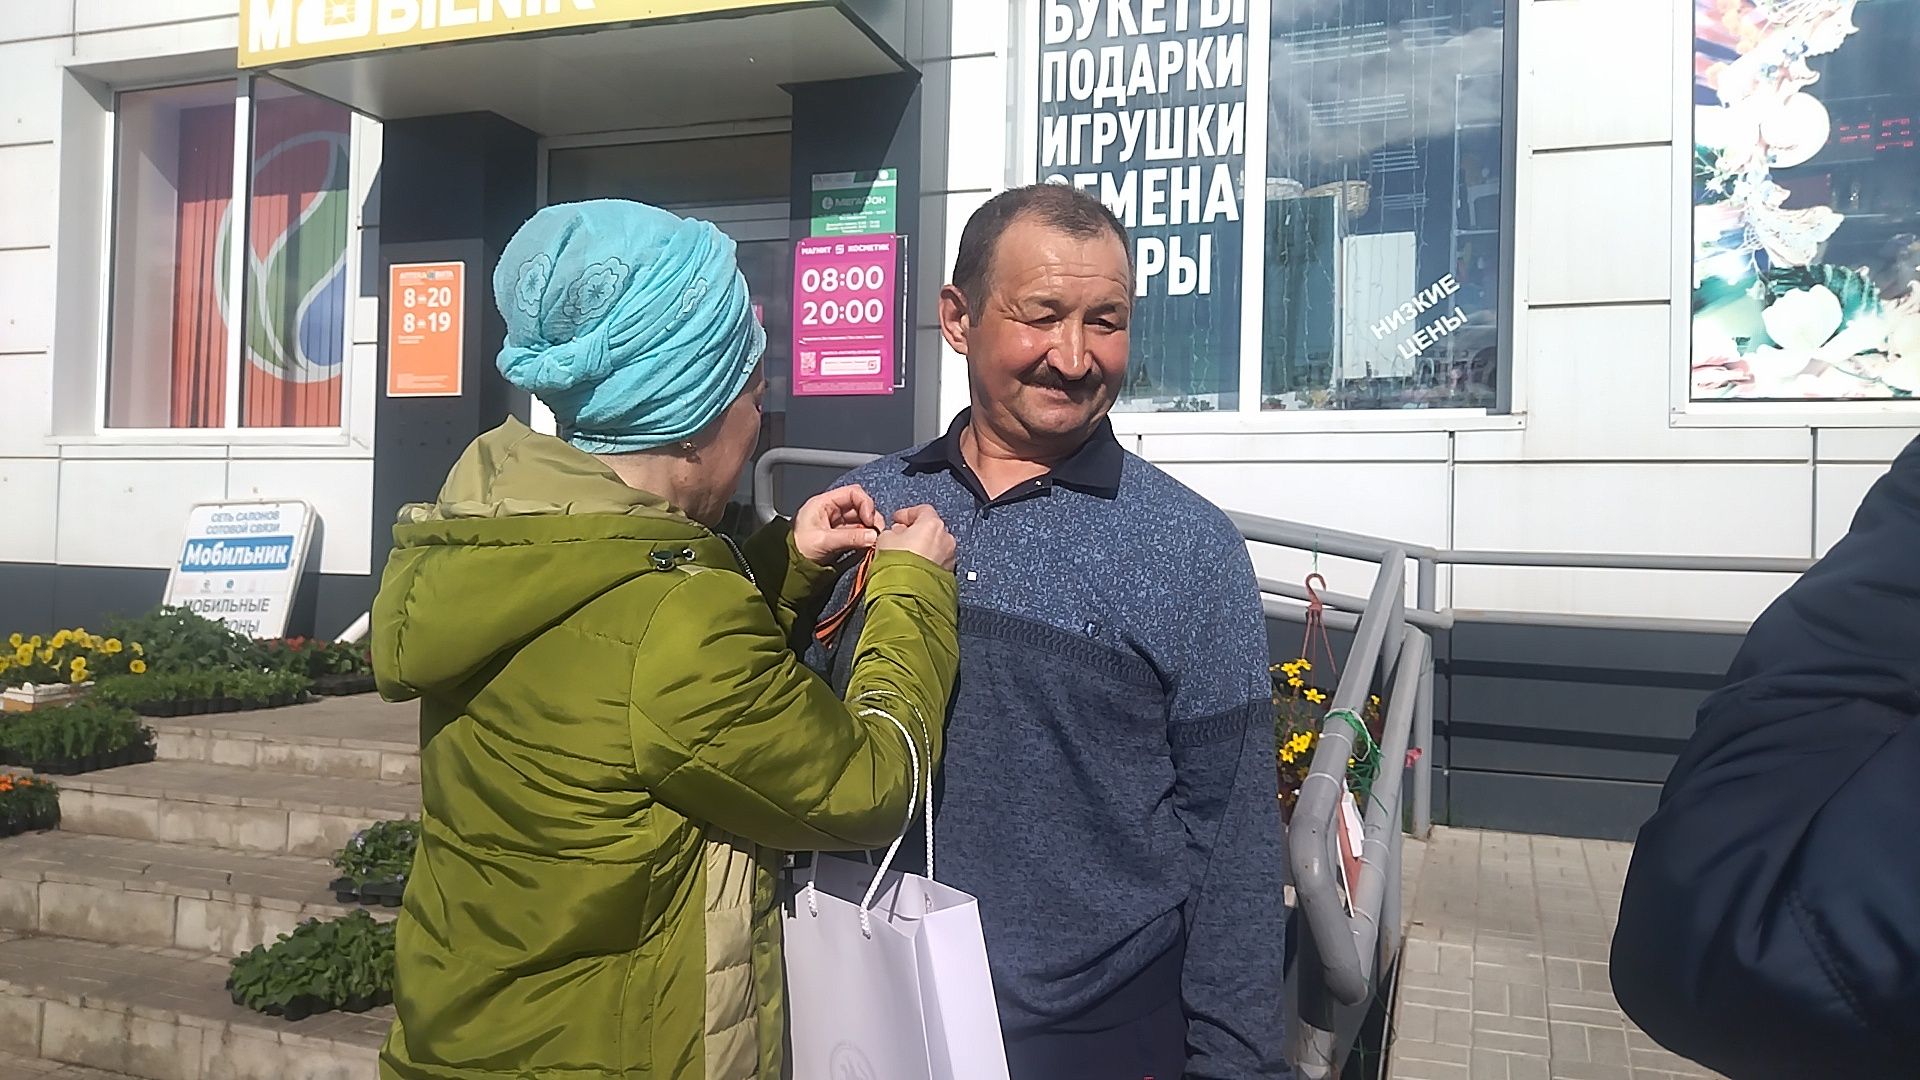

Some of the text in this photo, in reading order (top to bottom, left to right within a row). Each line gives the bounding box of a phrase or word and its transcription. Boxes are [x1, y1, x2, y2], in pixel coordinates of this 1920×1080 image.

[1042, 33, 1244, 109] ПОДАРКИ
[1041, 101, 1246, 167] ИГРУШКИ
[1045, 163, 1240, 228] МЕНА
[801, 243, 890, 256] МАГНИТ КОСМЕТИК
[801, 265, 885, 293] 08:00
[802, 298, 885, 326] 20:00
[1370, 273, 1460, 340] НИЗКИЕ
[1397, 306, 1468, 360] ЦЕНЫ
[206, 522, 281, 535] СОТОВОЙ СВЯЗИ
[210, 510, 280, 523] СЕТЬ САЛОНОВ
[185, 541, 290, 566] Мобильник
